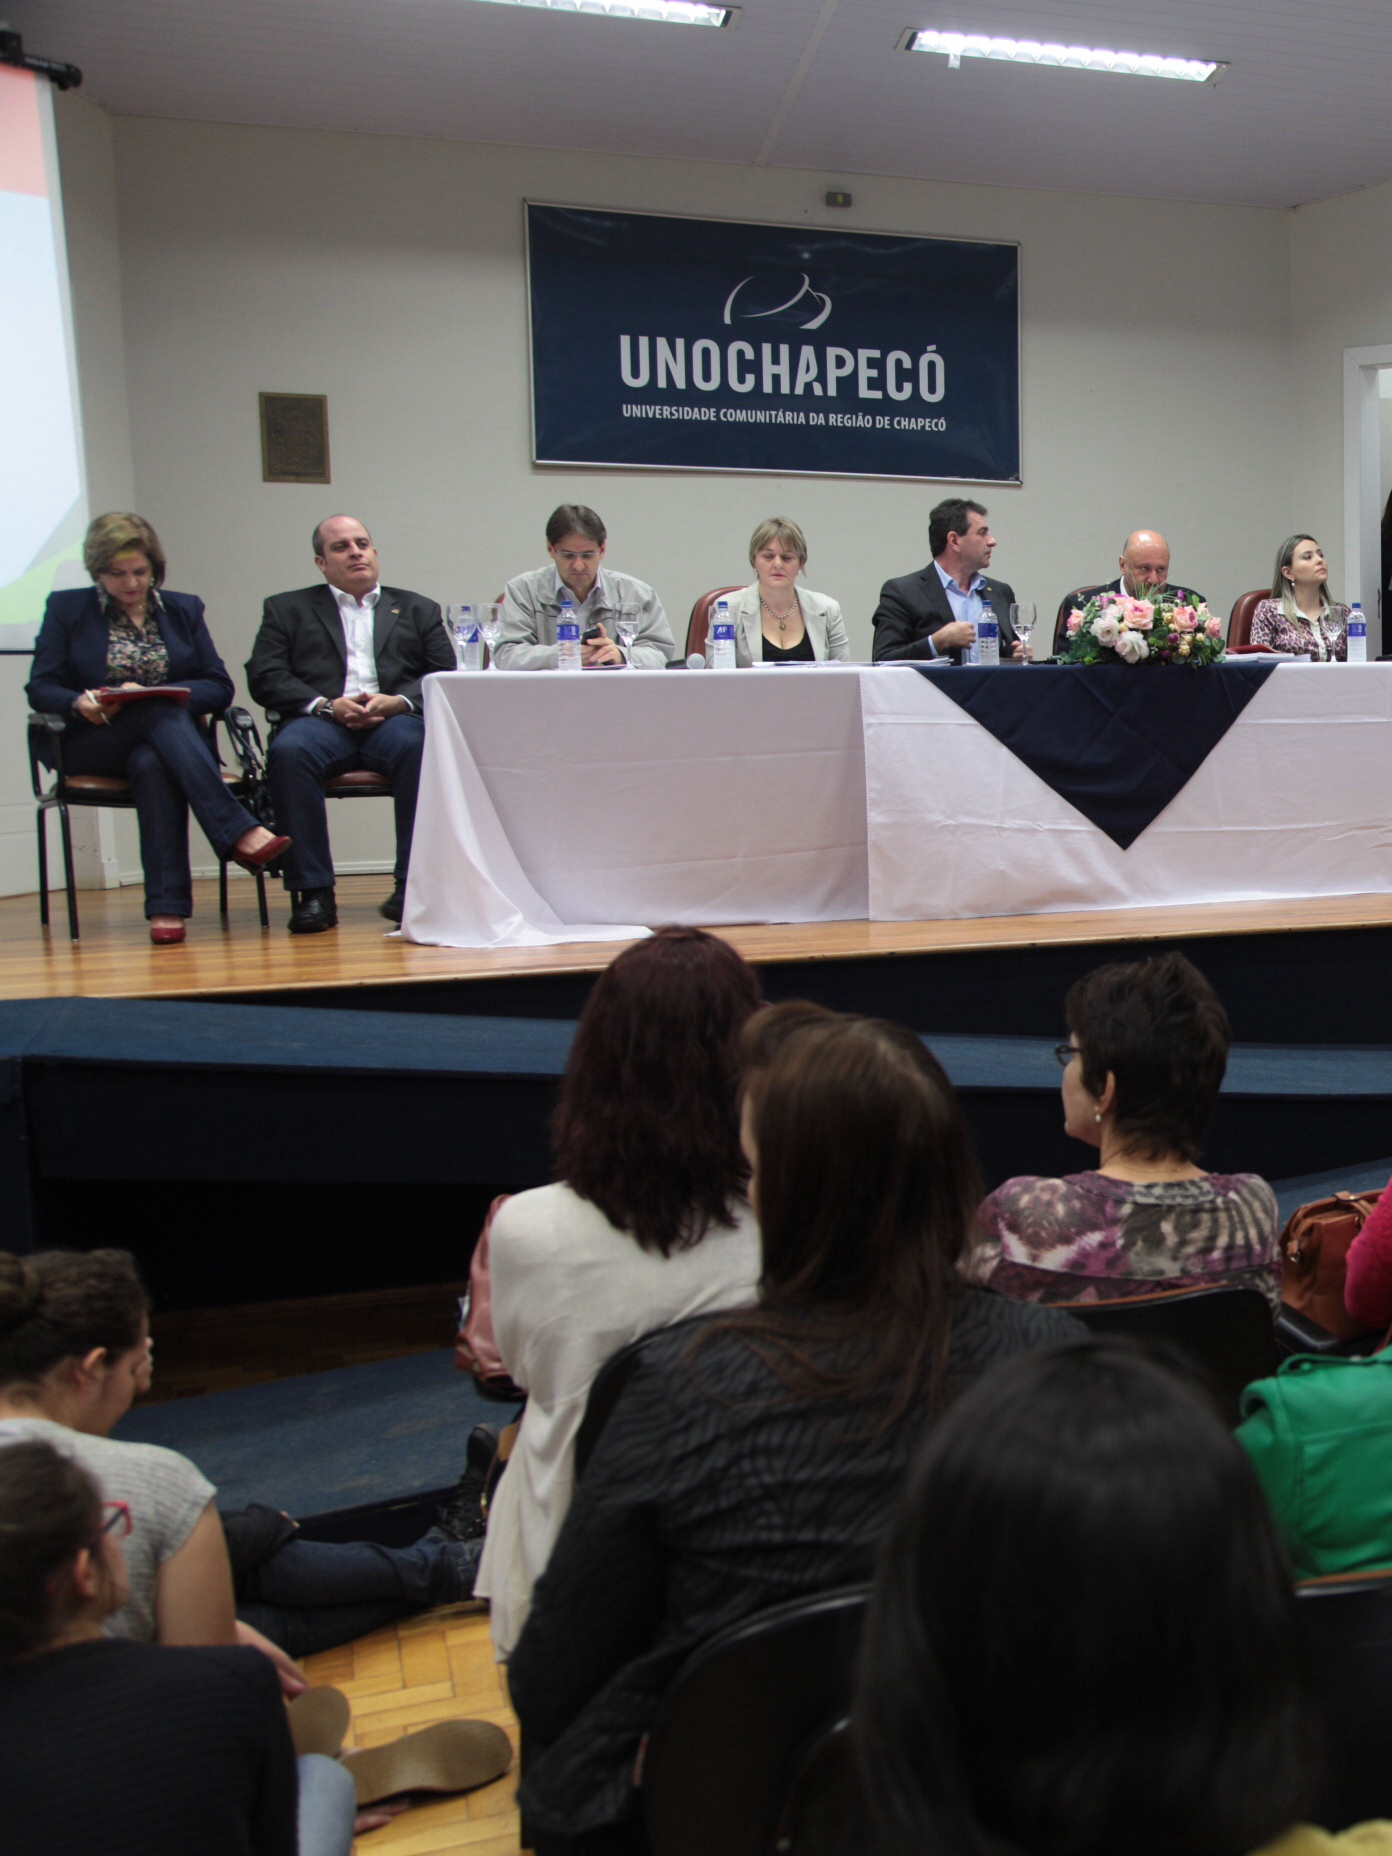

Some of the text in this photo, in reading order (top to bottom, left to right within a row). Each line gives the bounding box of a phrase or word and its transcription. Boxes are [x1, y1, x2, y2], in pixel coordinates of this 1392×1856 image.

[619, 333, 946, 403] UNOCHAPECÓ
[622, 403, 947, 432] UNIVERSIDADE COMUNITÁRIA DA REGIÃO DE CHAPECÓ
